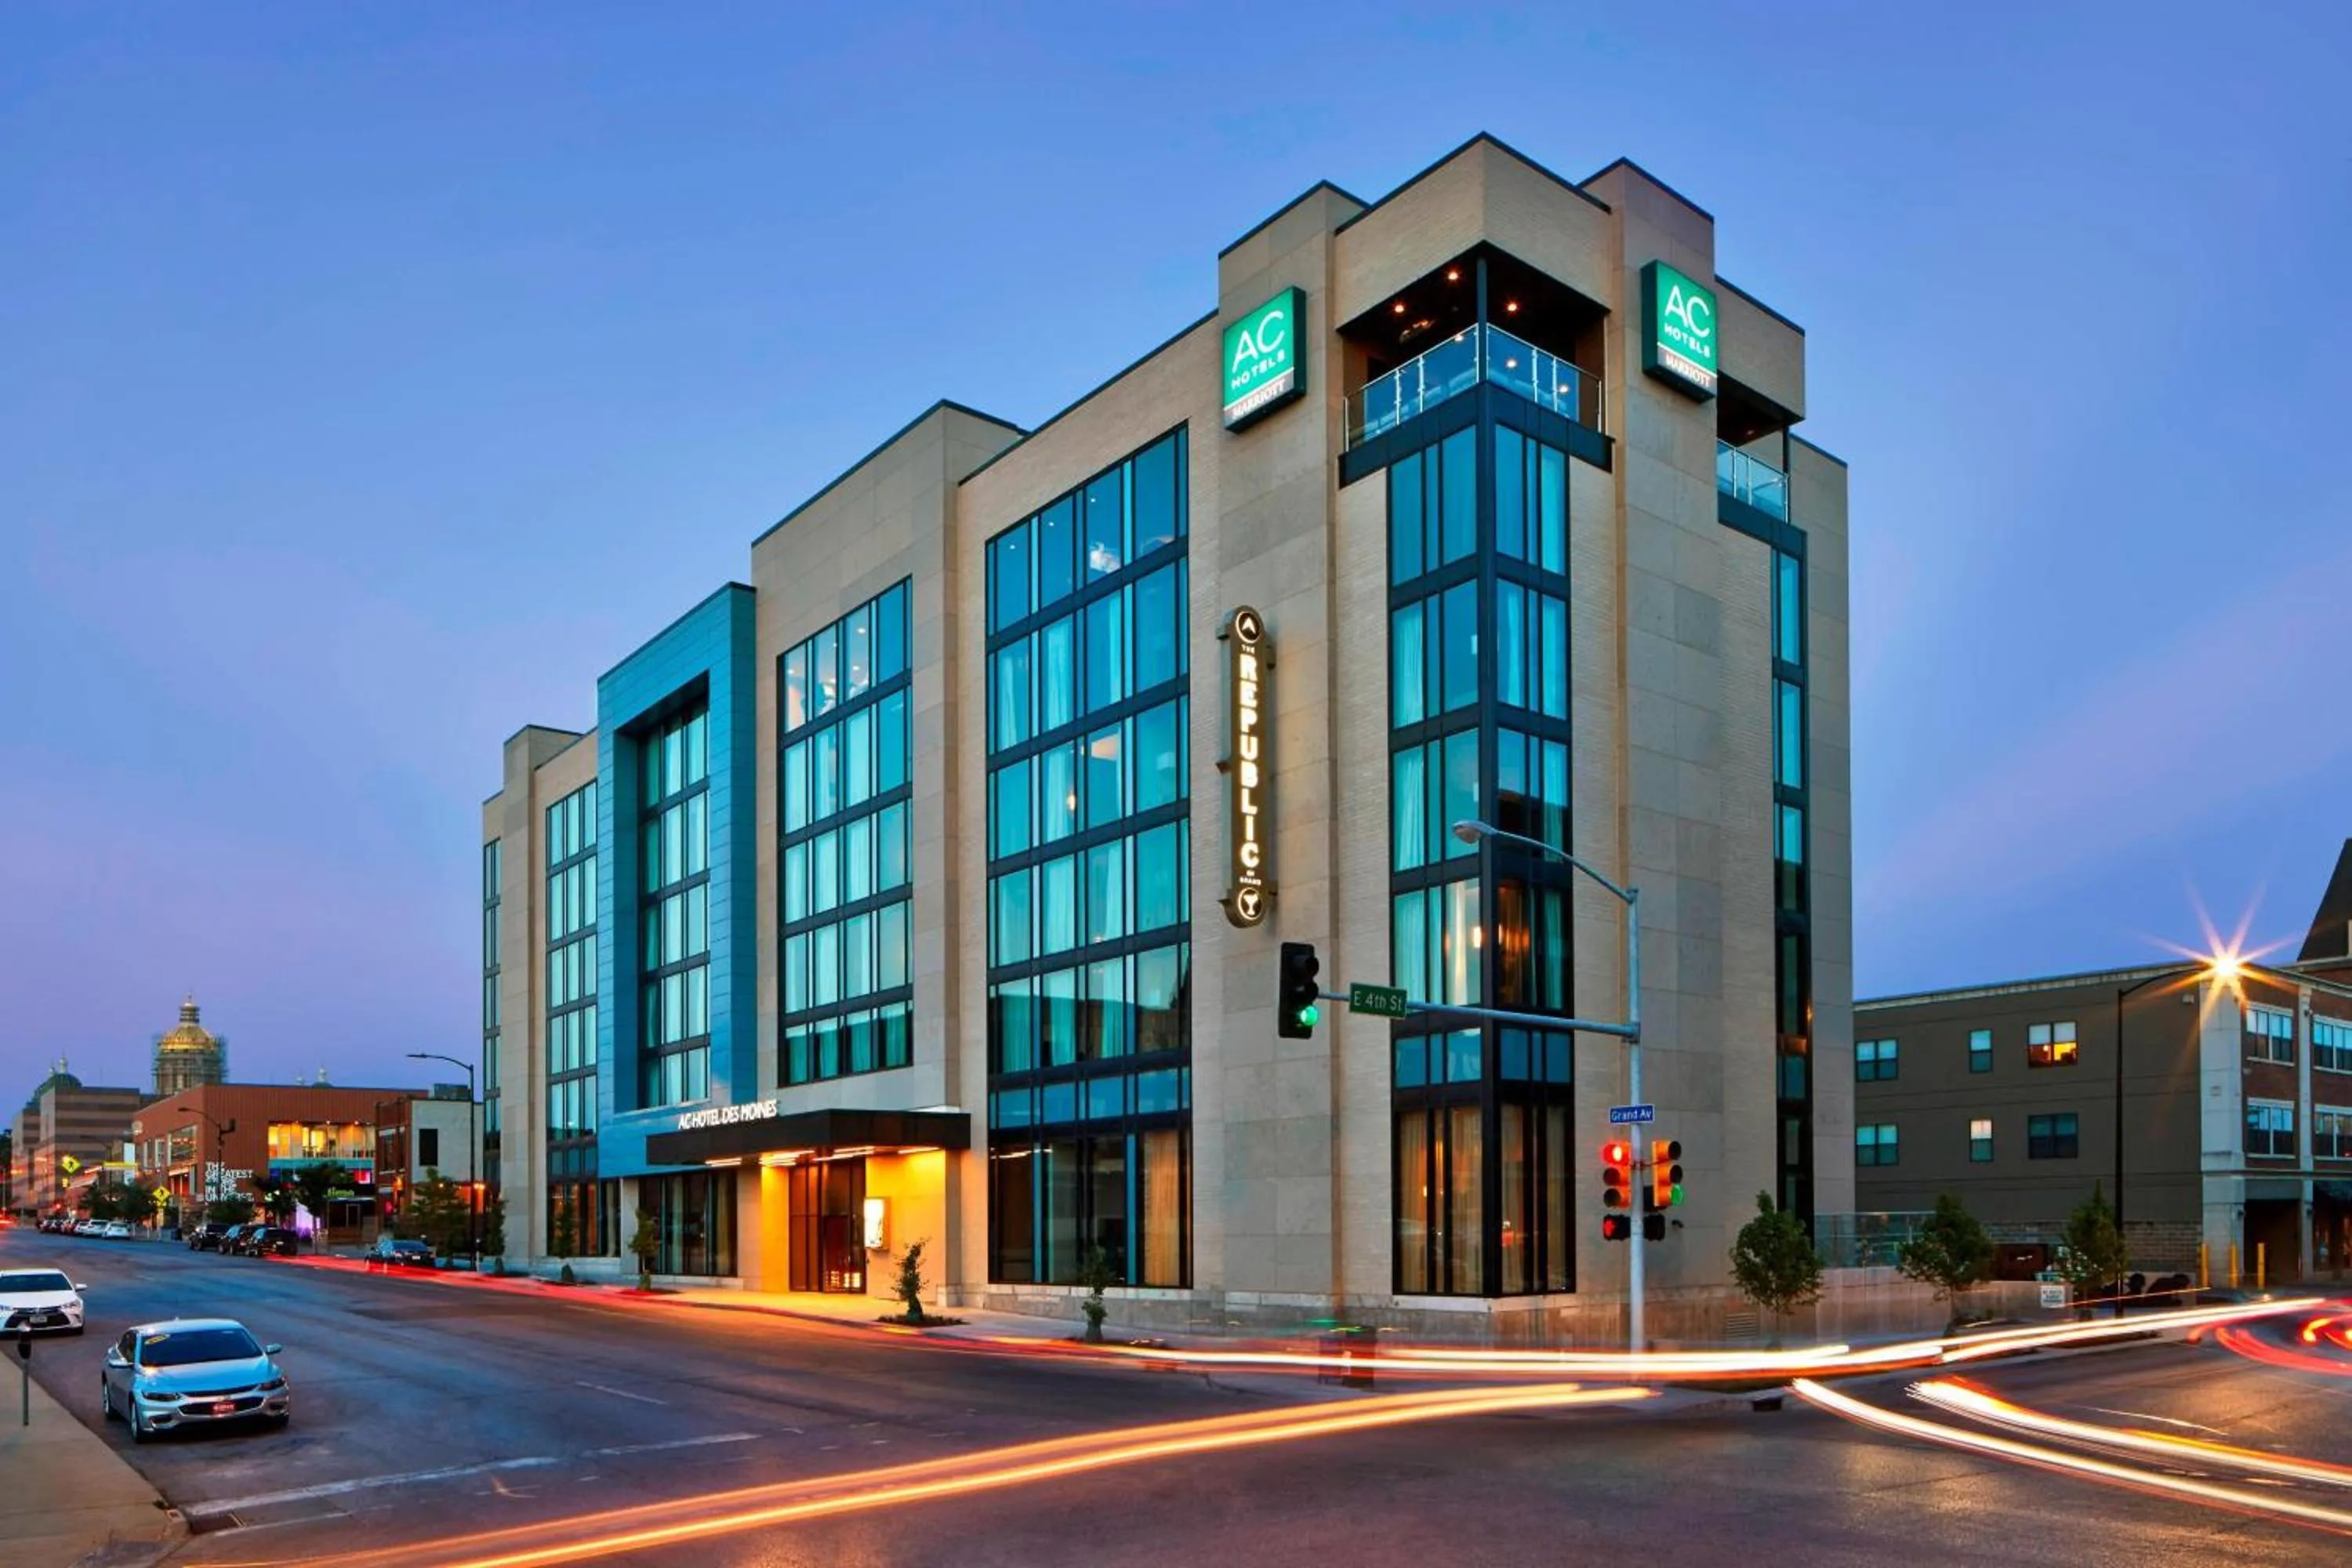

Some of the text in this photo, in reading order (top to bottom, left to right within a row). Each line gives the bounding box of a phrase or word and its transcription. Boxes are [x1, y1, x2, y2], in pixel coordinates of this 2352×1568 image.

[1664, 285, 1710, 338] AC
[1232, 310, 1286, 373] AC
[1664, 322, 1711, 358] HOTELS
[1231, 349, 1286, 390] HOTELS
[1232, 377, 1286, 419] MARRIOTT
[1241, 644, 1255, 654] THE
[1240, 653, 1259, 868] REPUBLIC
[1354, 990, 1402, 1011] E 4th St
[678, 1098, 778, 1130] AC HOTEL DES MOINES
[1611, 1109, 1638, 1121] Grand
